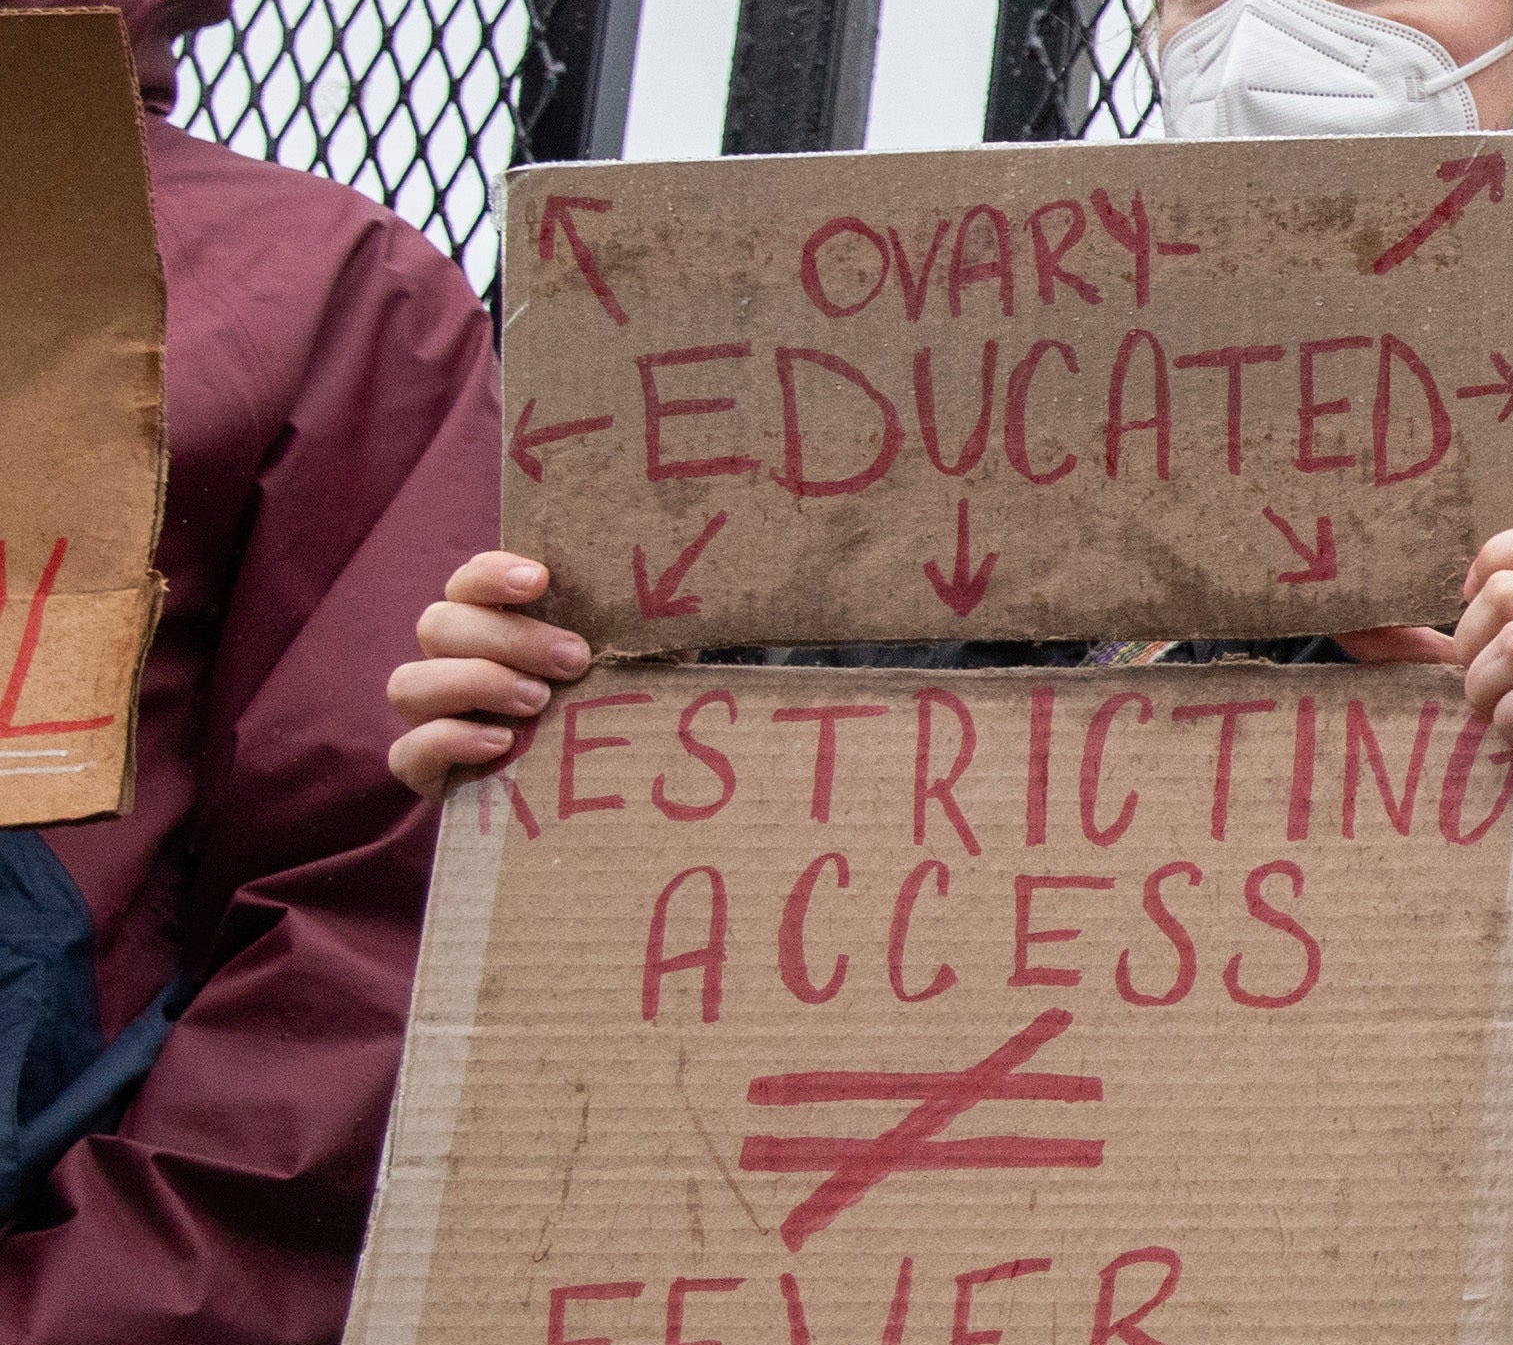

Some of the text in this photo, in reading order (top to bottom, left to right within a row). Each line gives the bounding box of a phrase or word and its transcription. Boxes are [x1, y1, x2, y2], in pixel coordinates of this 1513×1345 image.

[799, 189, 1203, 324] OVARY-
[638, 329, 1458, 499] EDUCATED
[640, 851, 1323, 1023] ACCESS
